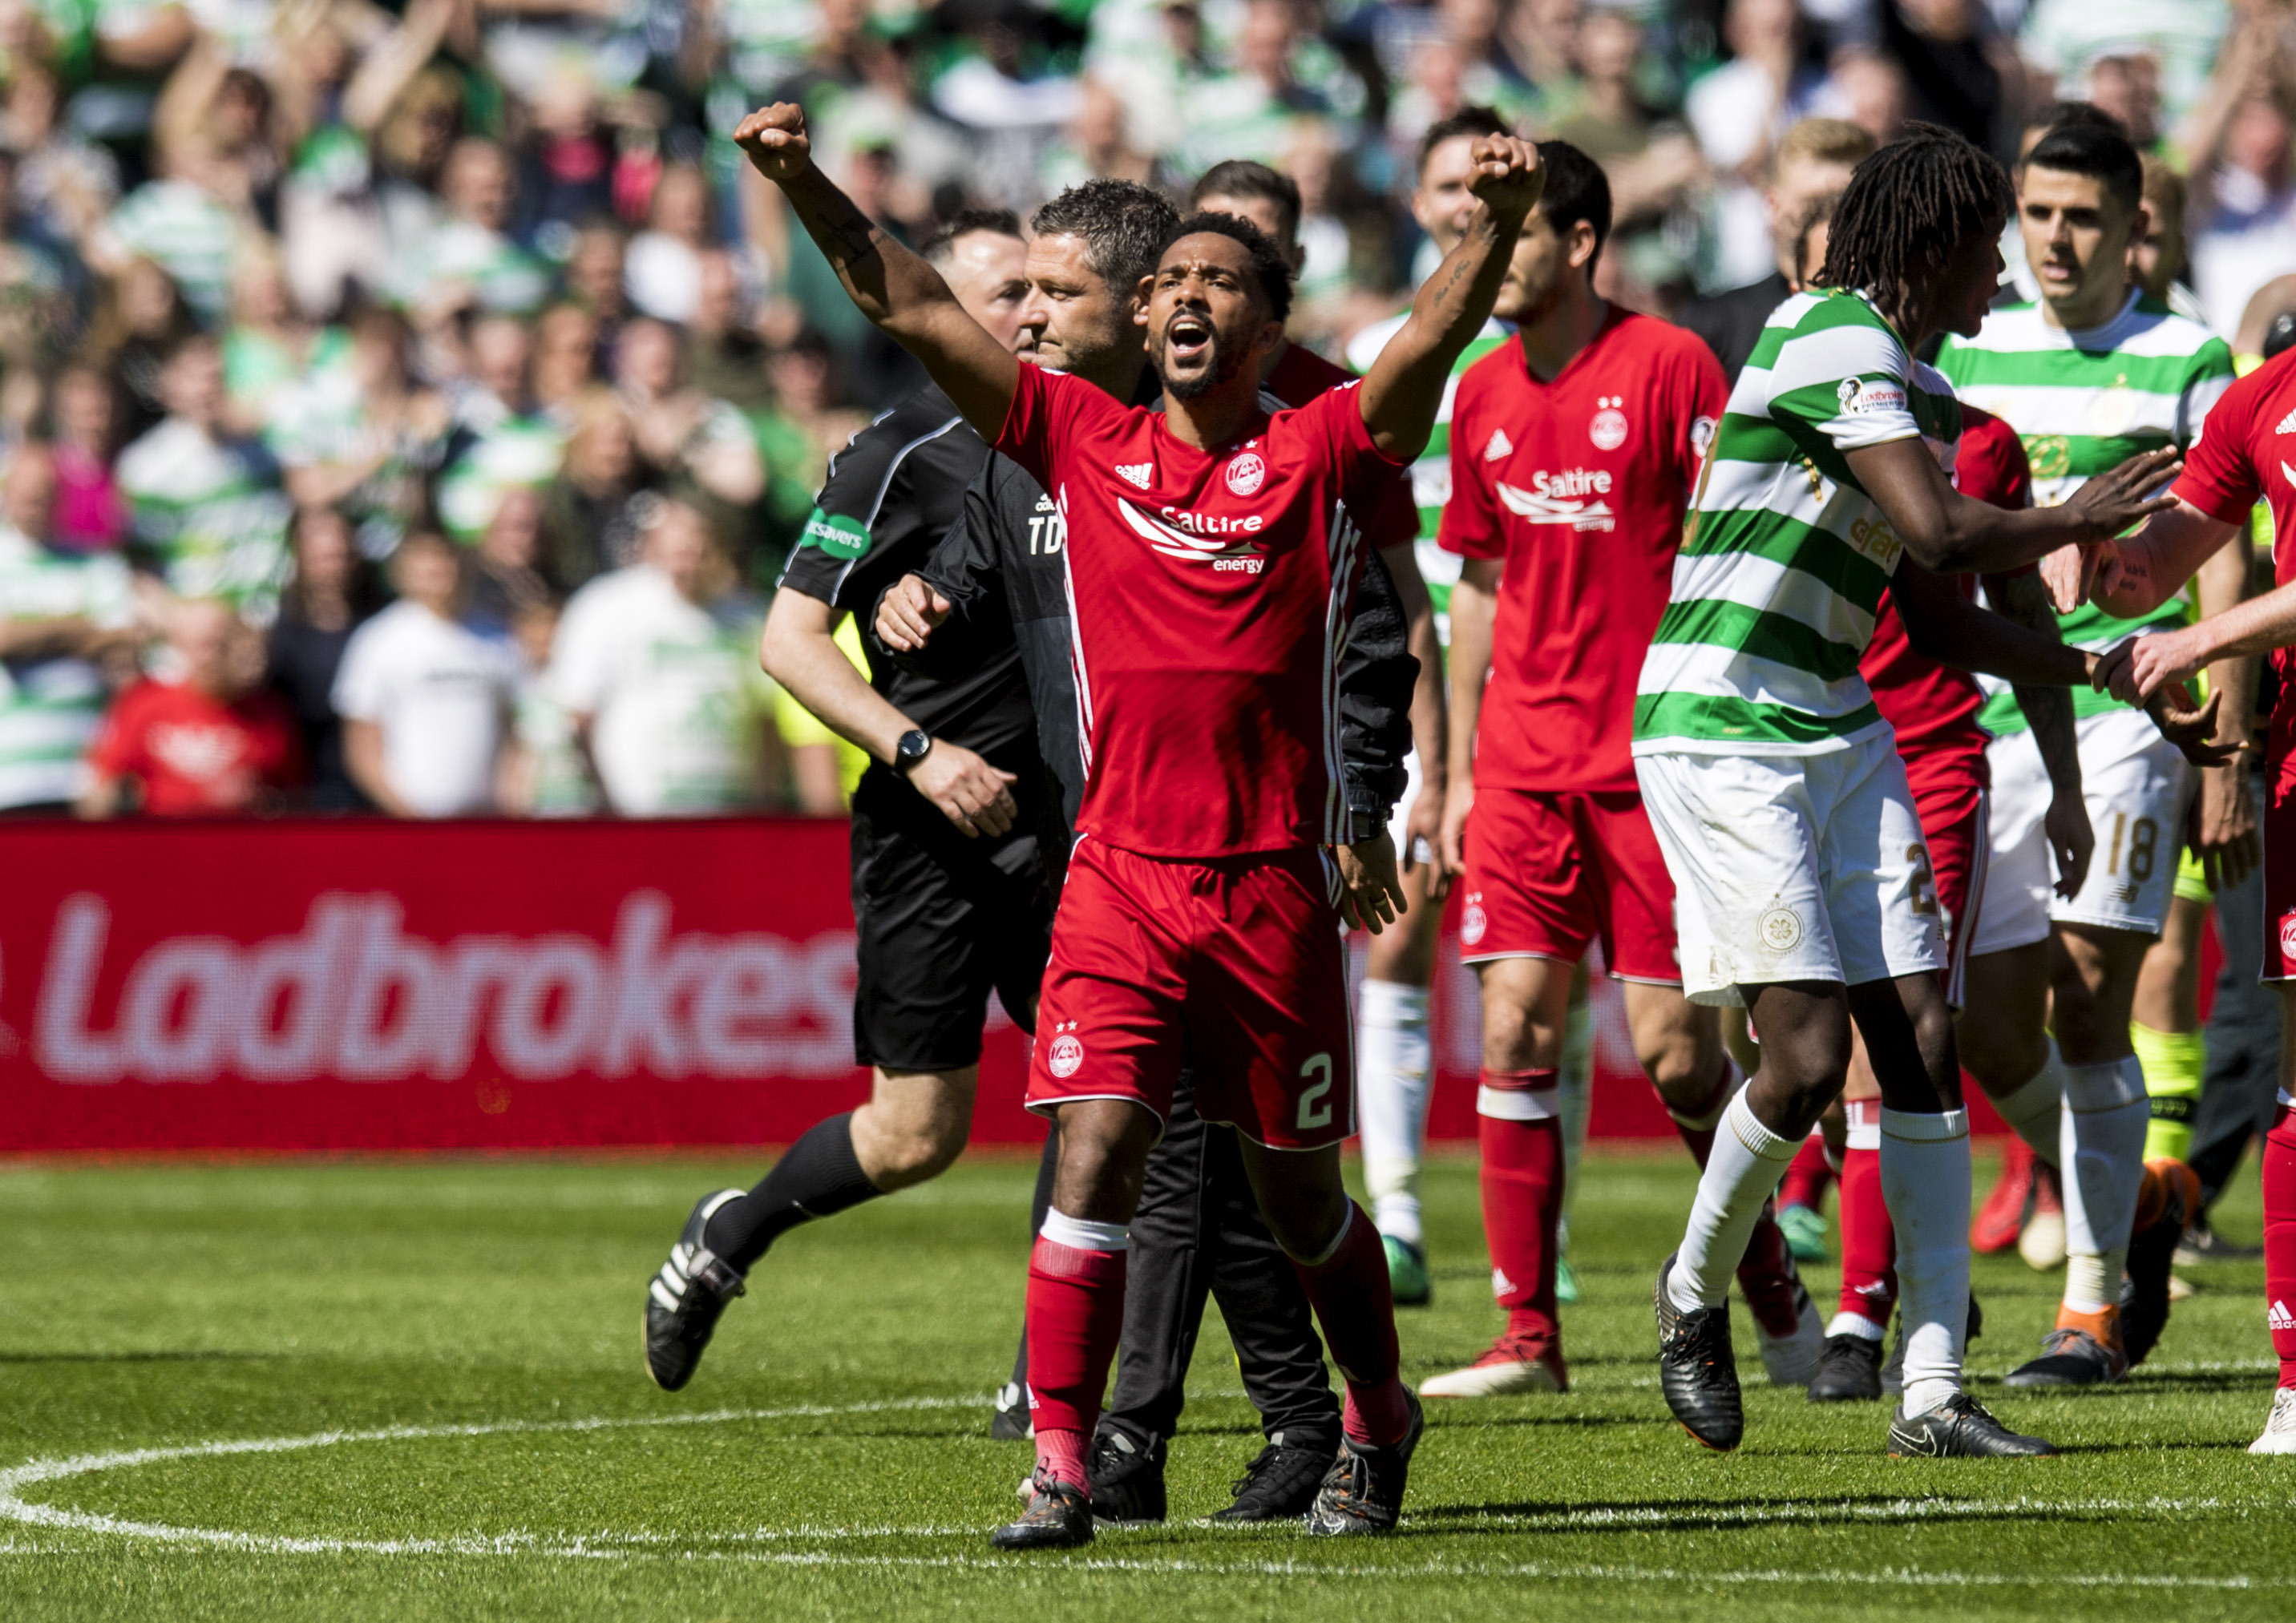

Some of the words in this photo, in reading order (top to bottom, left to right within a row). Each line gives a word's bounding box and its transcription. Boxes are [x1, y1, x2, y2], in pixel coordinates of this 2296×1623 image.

[1115, 465, 1151, 490] adidas
[1532, 466, 1612, 501] Saltire
[1028, 515, 1065, 555] TD
[1161, 507, 1263, 534] Saltire
[1213, 559, 1264, 574] energy
[2107, 811, 2159, 880] 18
[32, 888, 858, 1084] Ladbrokes
[1296, 1052, 1332, 1128] 2
